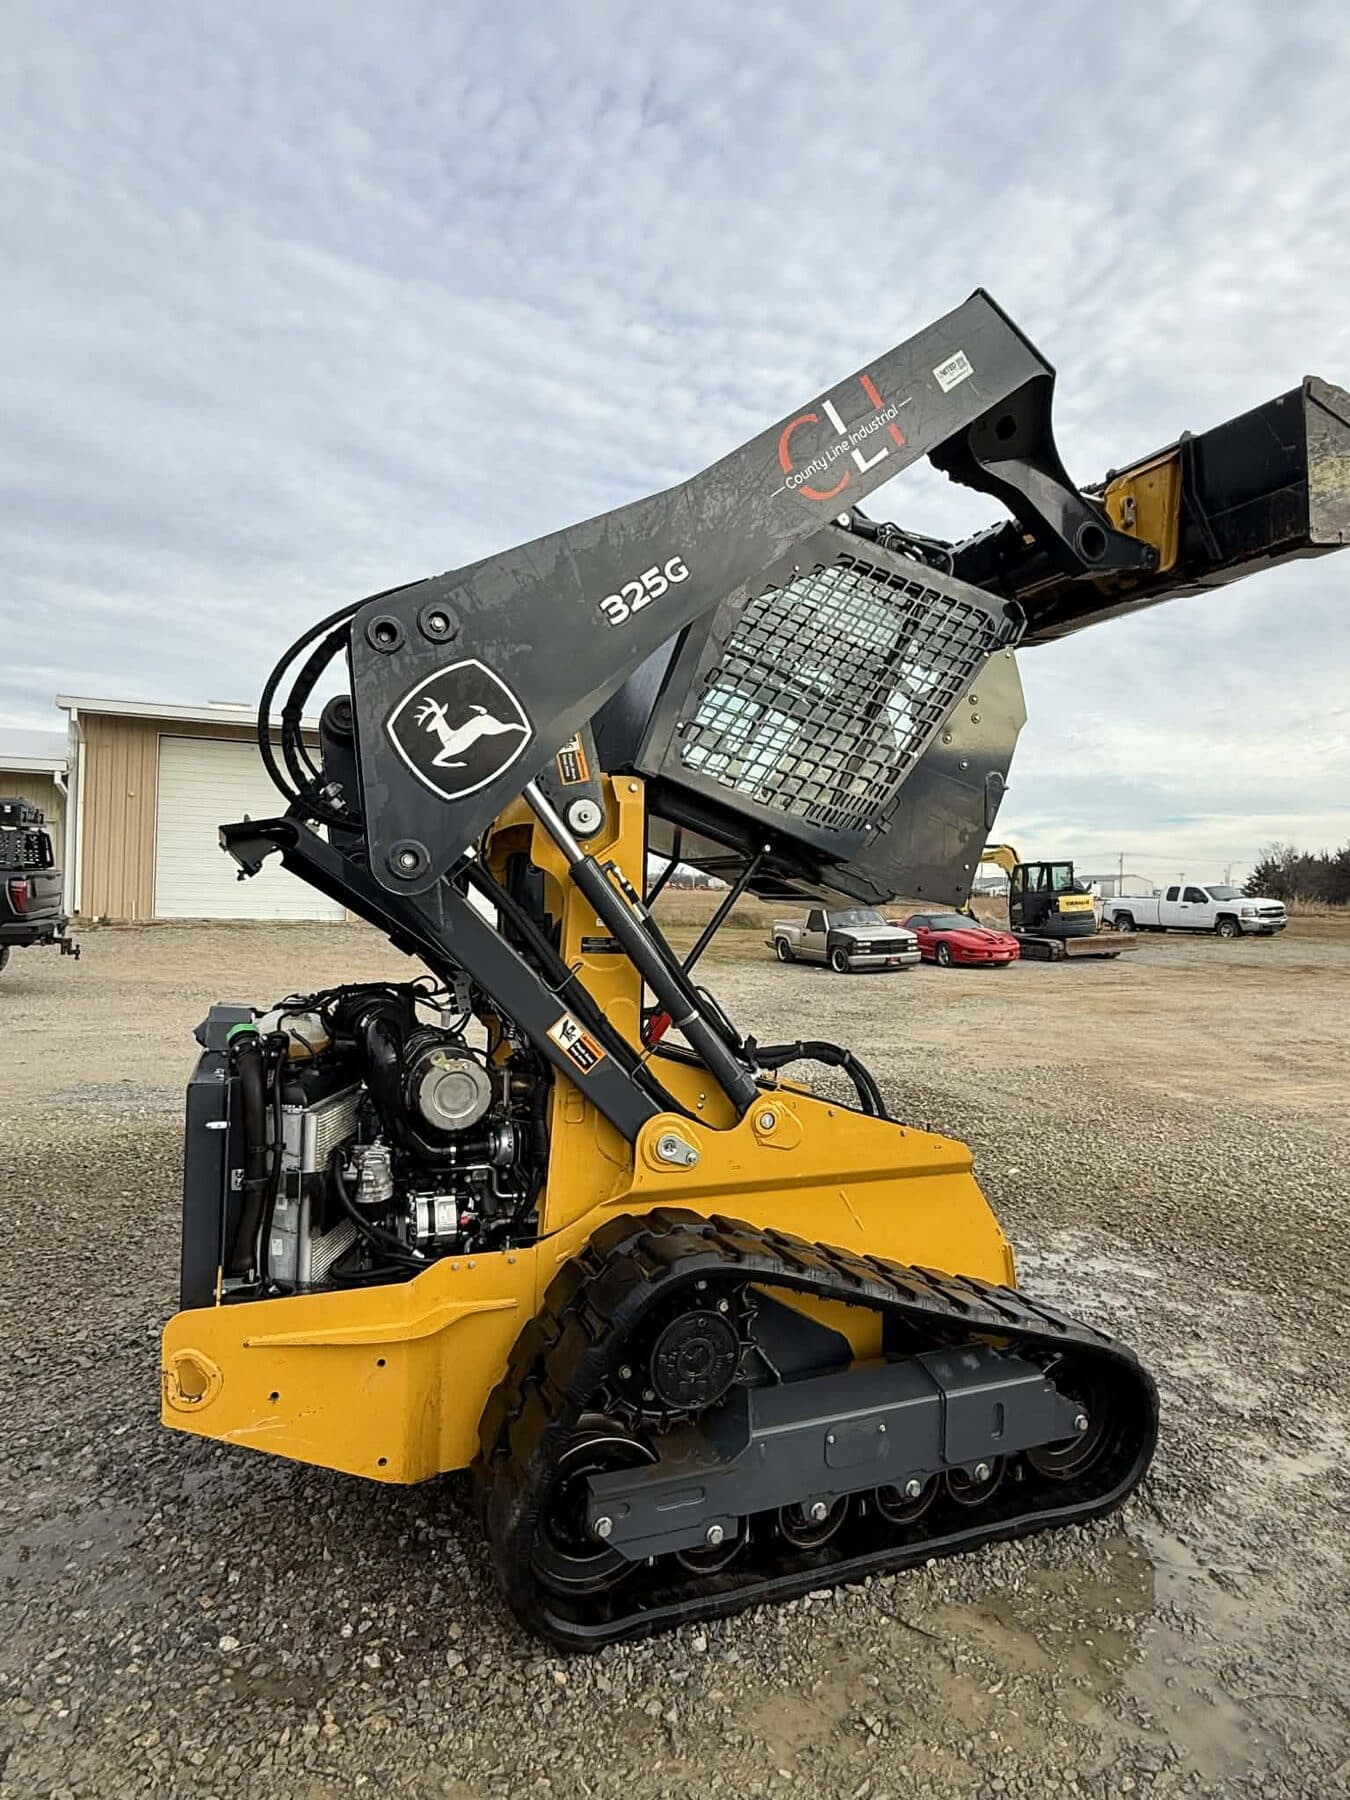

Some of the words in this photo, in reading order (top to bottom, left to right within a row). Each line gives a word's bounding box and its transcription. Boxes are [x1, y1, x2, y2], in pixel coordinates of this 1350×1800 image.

[785, 459, 829, 490] County
[825, 440, 851, 461] Line
[848, 403, 899, 446] Industrial
[599, 556, 689, 625] 325G
